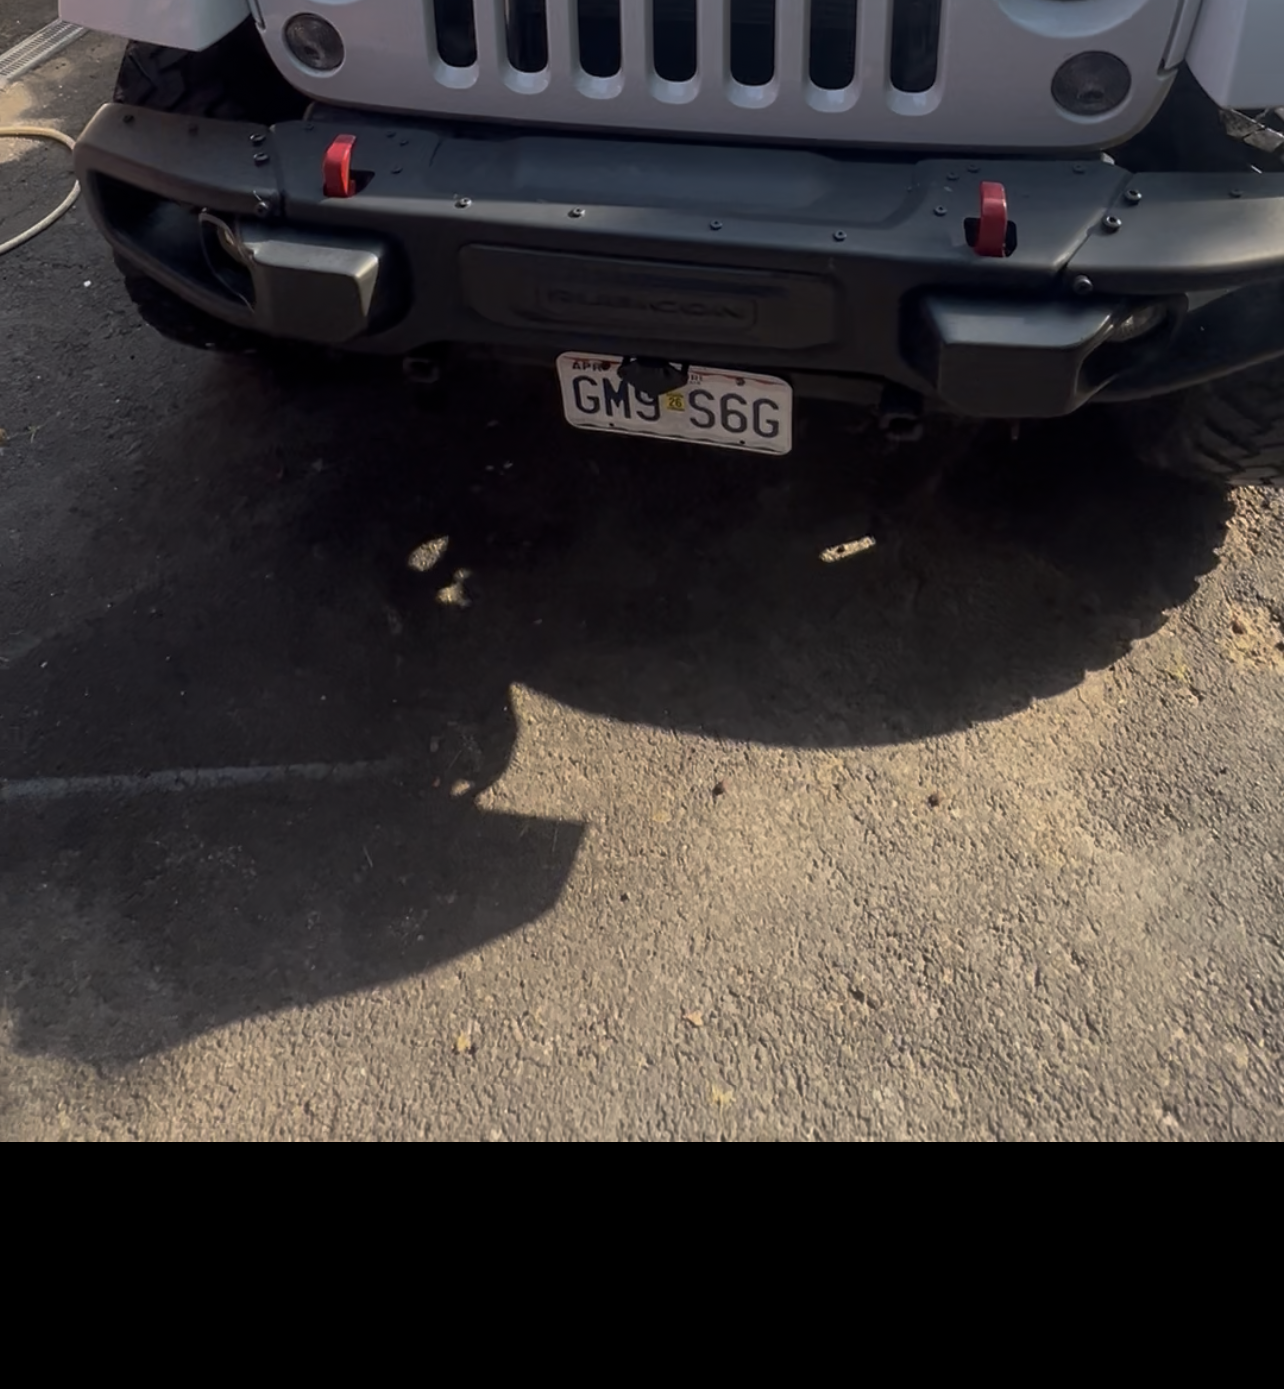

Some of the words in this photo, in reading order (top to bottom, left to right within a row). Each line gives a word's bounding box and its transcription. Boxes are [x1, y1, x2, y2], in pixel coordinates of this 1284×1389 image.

[572, 361, 602, 372] APR
[572, 375, 661, 422] GM9
[688, 389, 780, 439] S6G
[668, 397, 682, 408] 26
